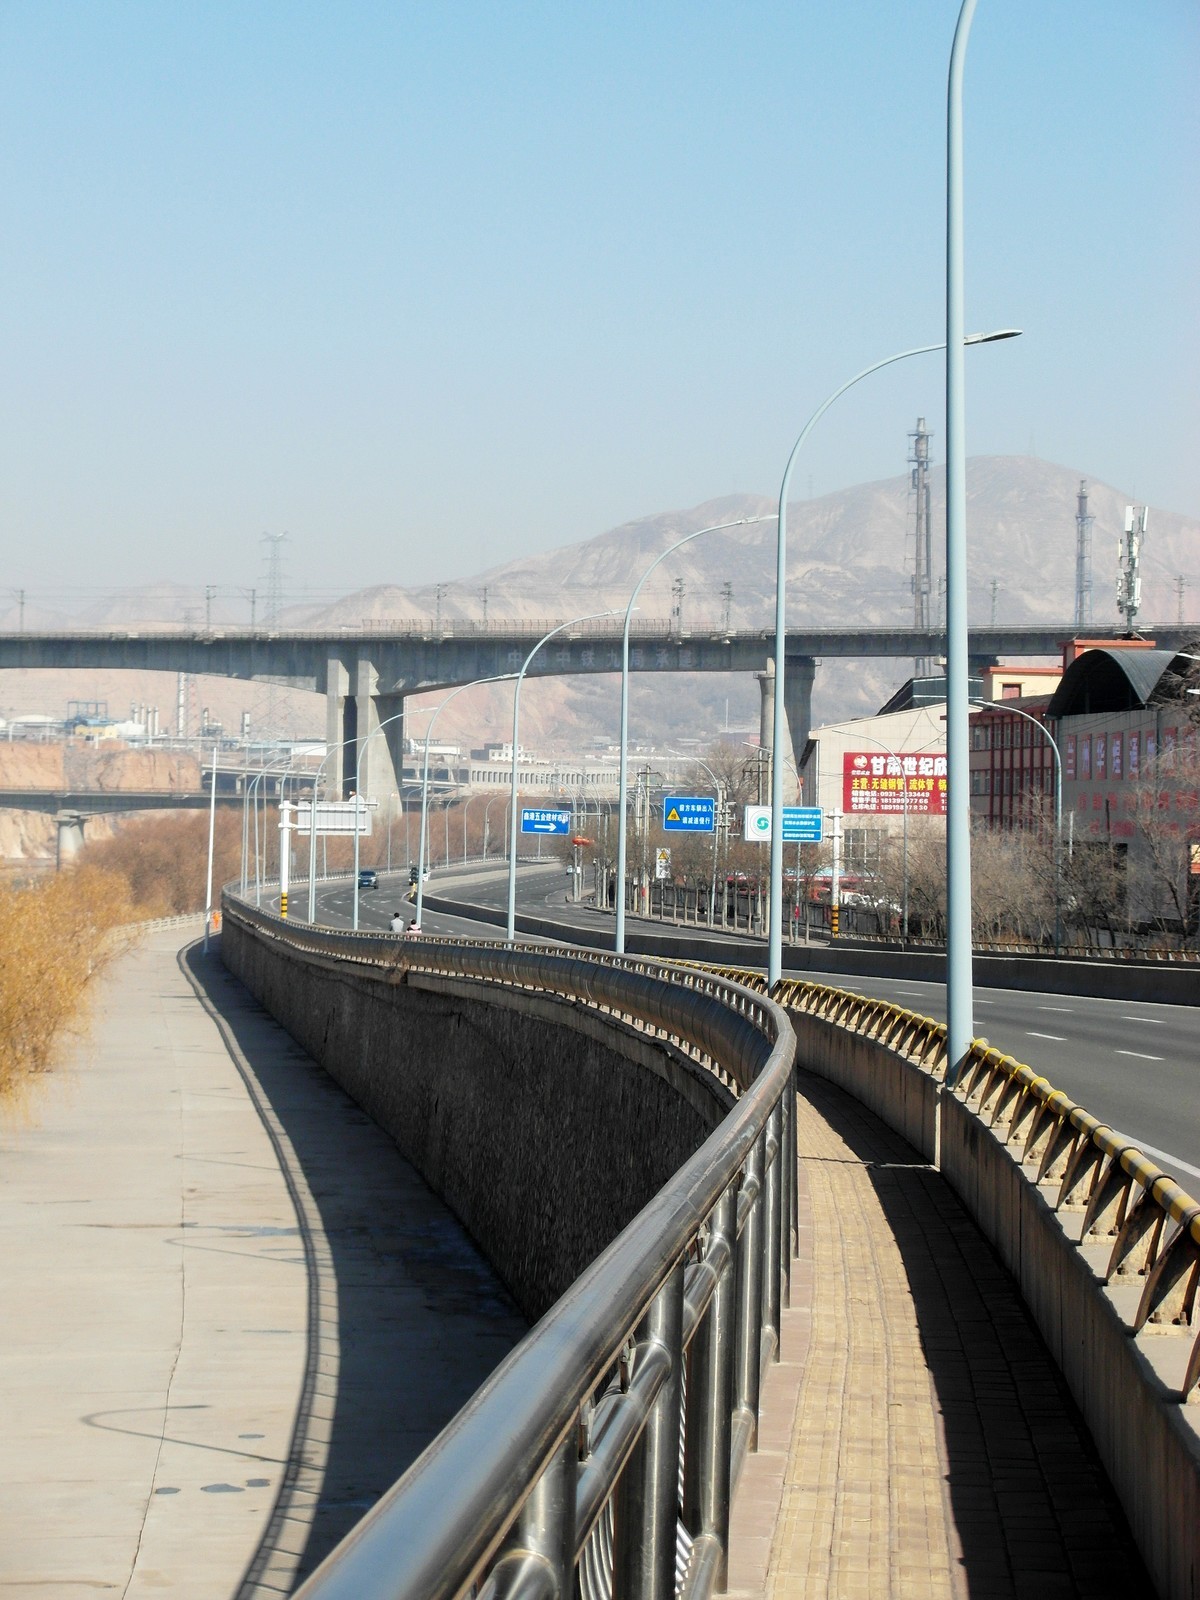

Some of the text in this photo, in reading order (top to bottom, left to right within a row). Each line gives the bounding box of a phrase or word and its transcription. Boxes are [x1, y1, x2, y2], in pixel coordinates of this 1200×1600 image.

[507, 648, 692, 669] 中国中铁九局承建
[909, 778, 934, 791] 流体管
[679, 804, 713, 812] 前方车辆出入
